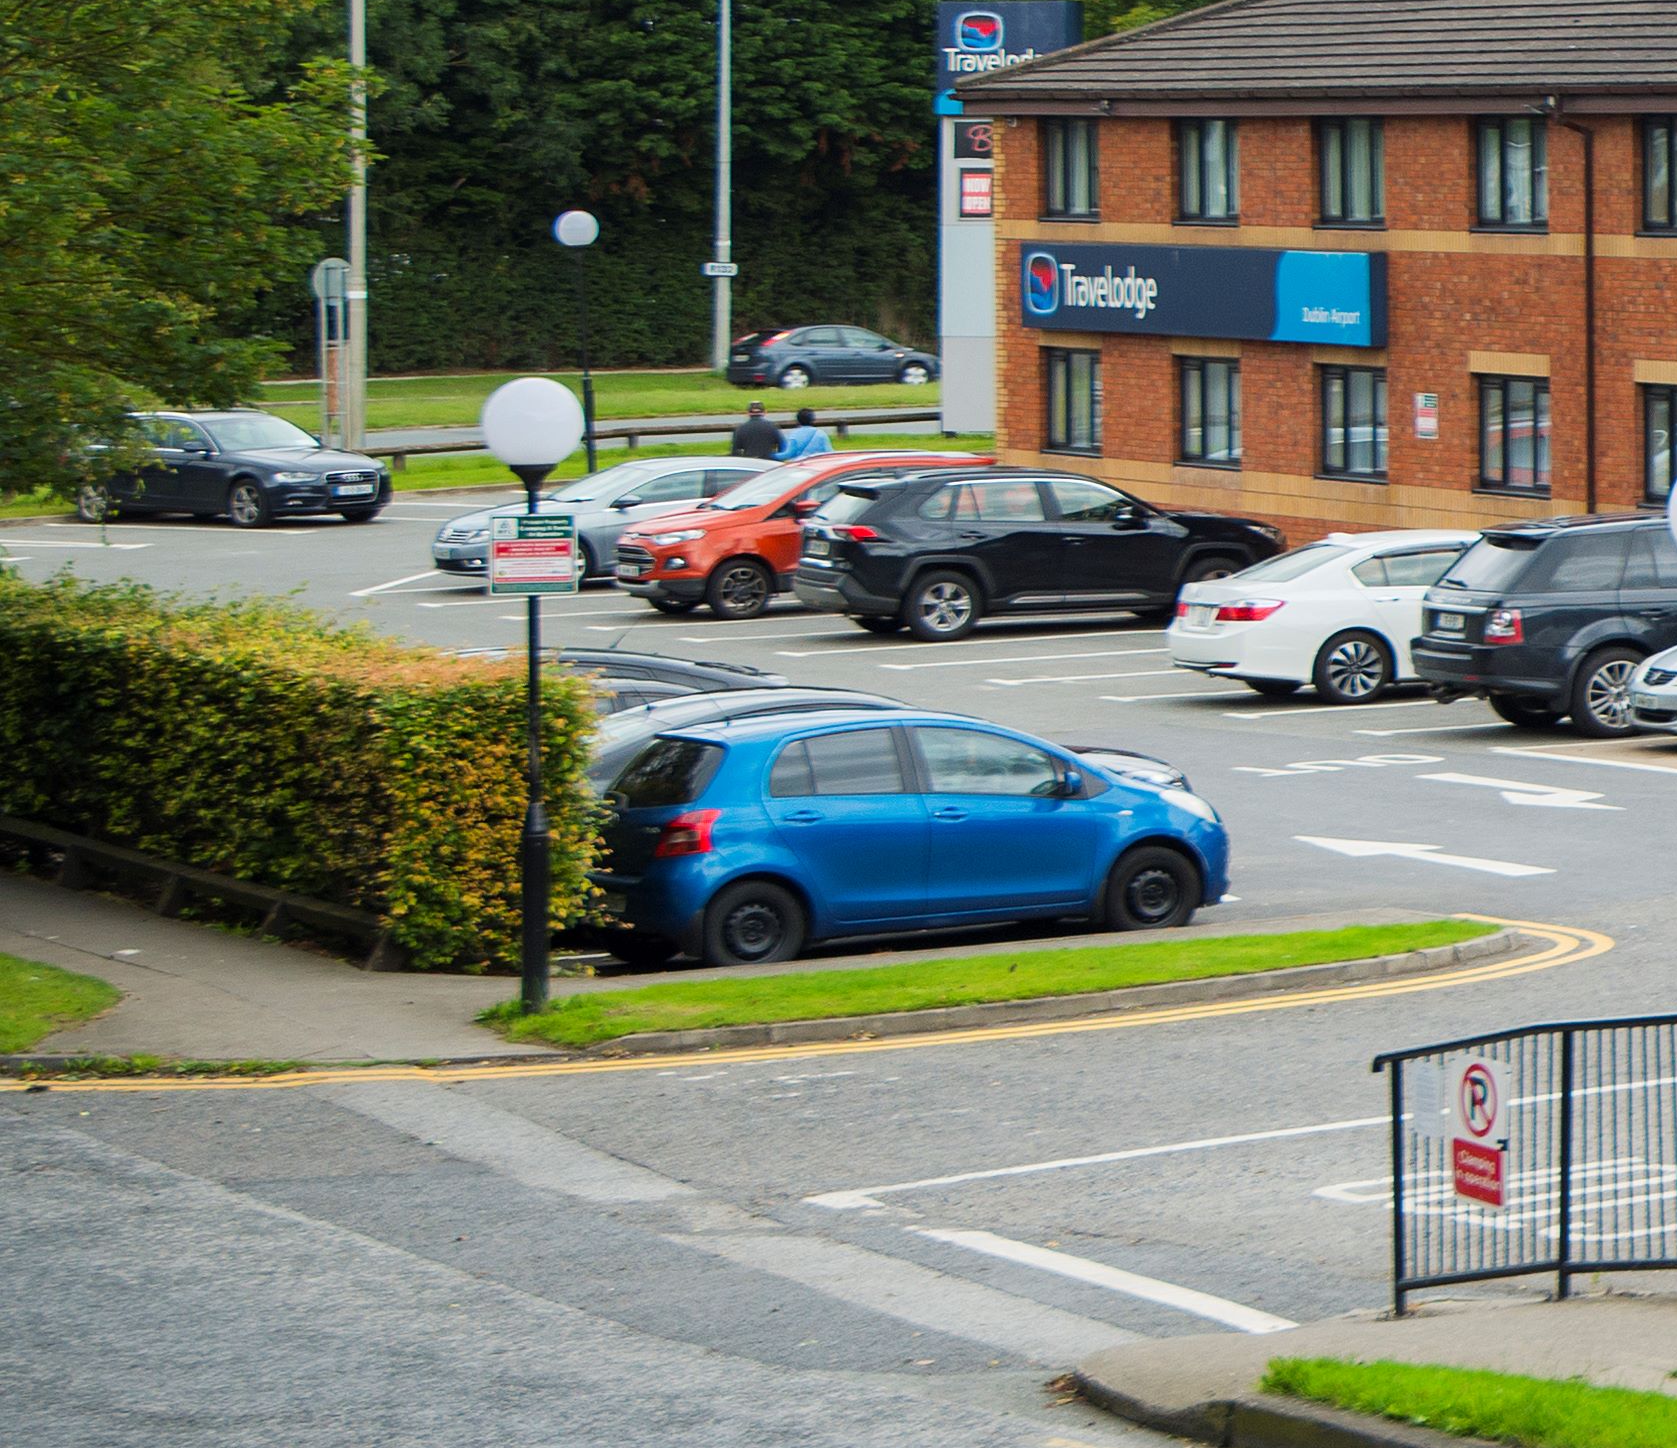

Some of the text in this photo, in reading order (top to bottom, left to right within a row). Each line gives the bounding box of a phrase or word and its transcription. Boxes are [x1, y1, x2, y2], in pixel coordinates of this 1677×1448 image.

[1060, 263, 1158, 319] Travelodge
[1302, 307, 1360, 327] Dublin Airport
